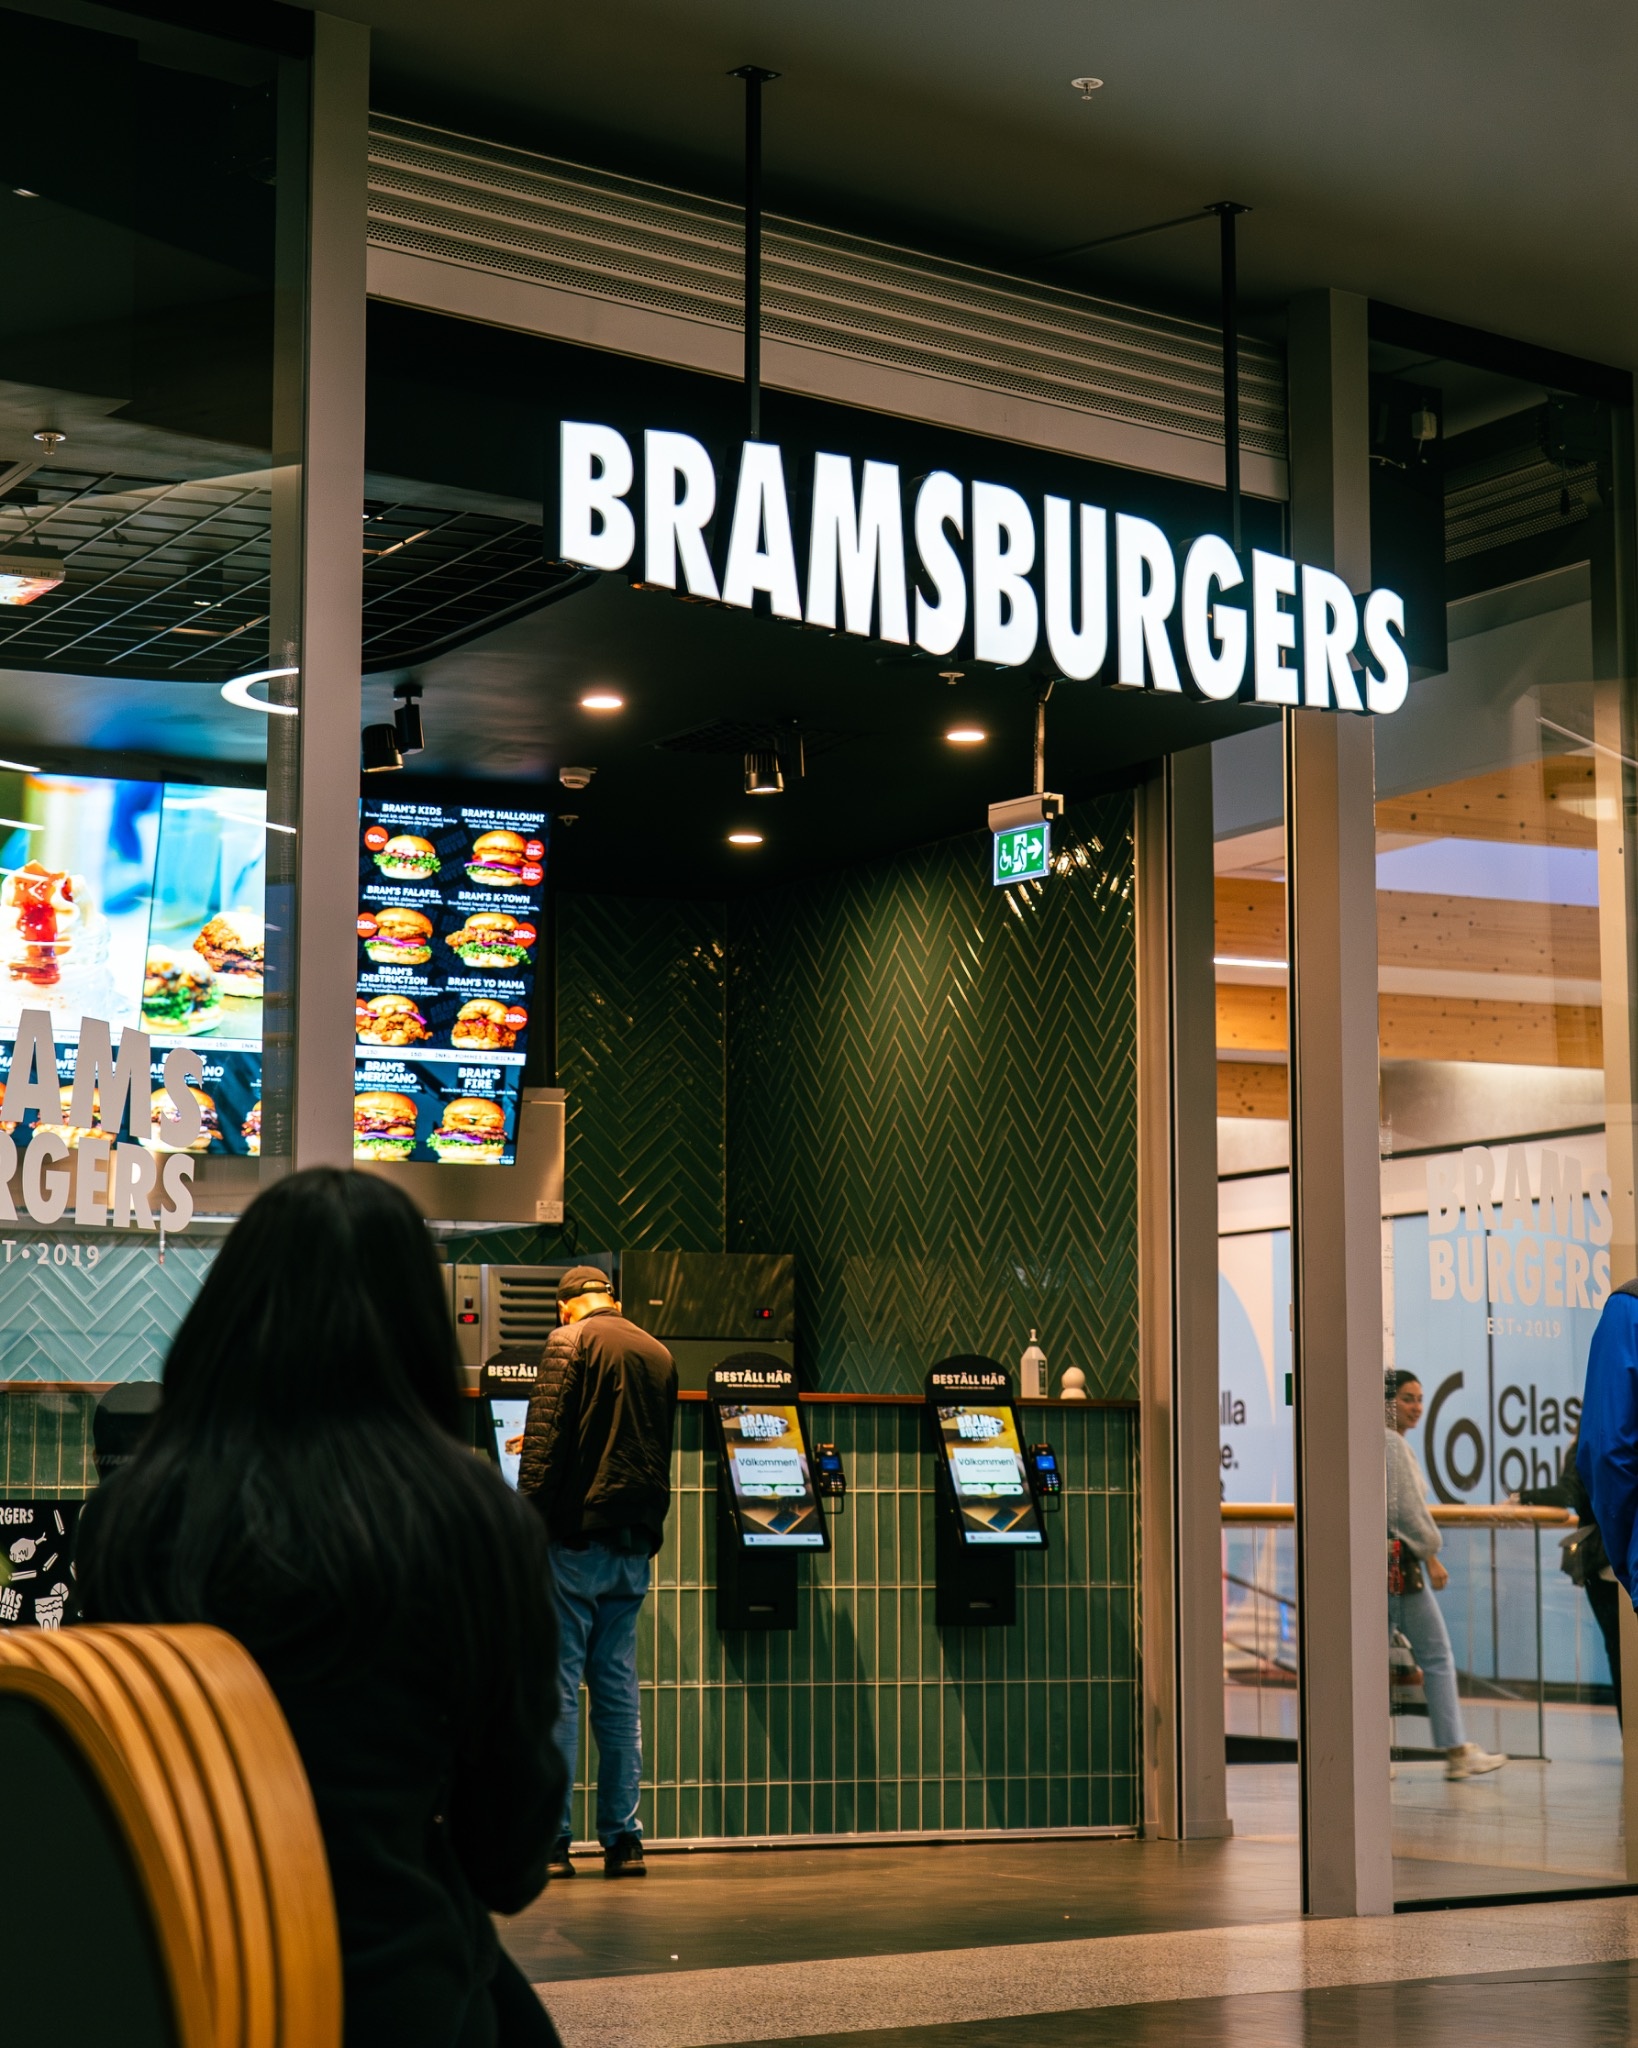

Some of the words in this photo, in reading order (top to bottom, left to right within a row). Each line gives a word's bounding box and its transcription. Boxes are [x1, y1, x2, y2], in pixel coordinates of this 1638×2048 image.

[559, 420, 1410, 715] BRAMSBURGERS
[382, 803, 416, 814] BRAM'S
[418, 806, 442, 816] KIDS
[462, 808, 494, 819] BRAM'S
[496, 811, 545, 822] HALLOUMI
[367, 885, 401, 895] BRAM'S
[403, 888, 441, 898] FALAFEL
[458, 891, 492, 901] BRAM'S
[493, 893, 530, 904] K-TOWN
[378, 966, 413, 976] BRAM'S
[361, 973, 428, 985] DESTRUCTION
[448, 976, 481, 987] BRAM'S
[483, 978, 496, 988] YO
[365, 1060, 405, 1073] BRAM'S
[1, 1008, 202, 1148] AMS
[458, 1067, 501, 1080] BRAM'S
[464, 1078, 493, 1089] FIRE
[0, 1130, 195, 1232] GERS
[1426, 1144, 1613, 1247] BRAMS
[1428, 1235, 1611, 1310] BURGERS
[715, 1369, 764, 1382] BESTÄLL
[766, 1370, 792, 1383] HÄR
[932, 1372, 979, 1385] BESTÄLL
[982, 1372, 1006, 1385] HÄR
[739, 1458, 797, 1466] Välkommen!
[958, 1458, 1014, 1466] Välkommen!
